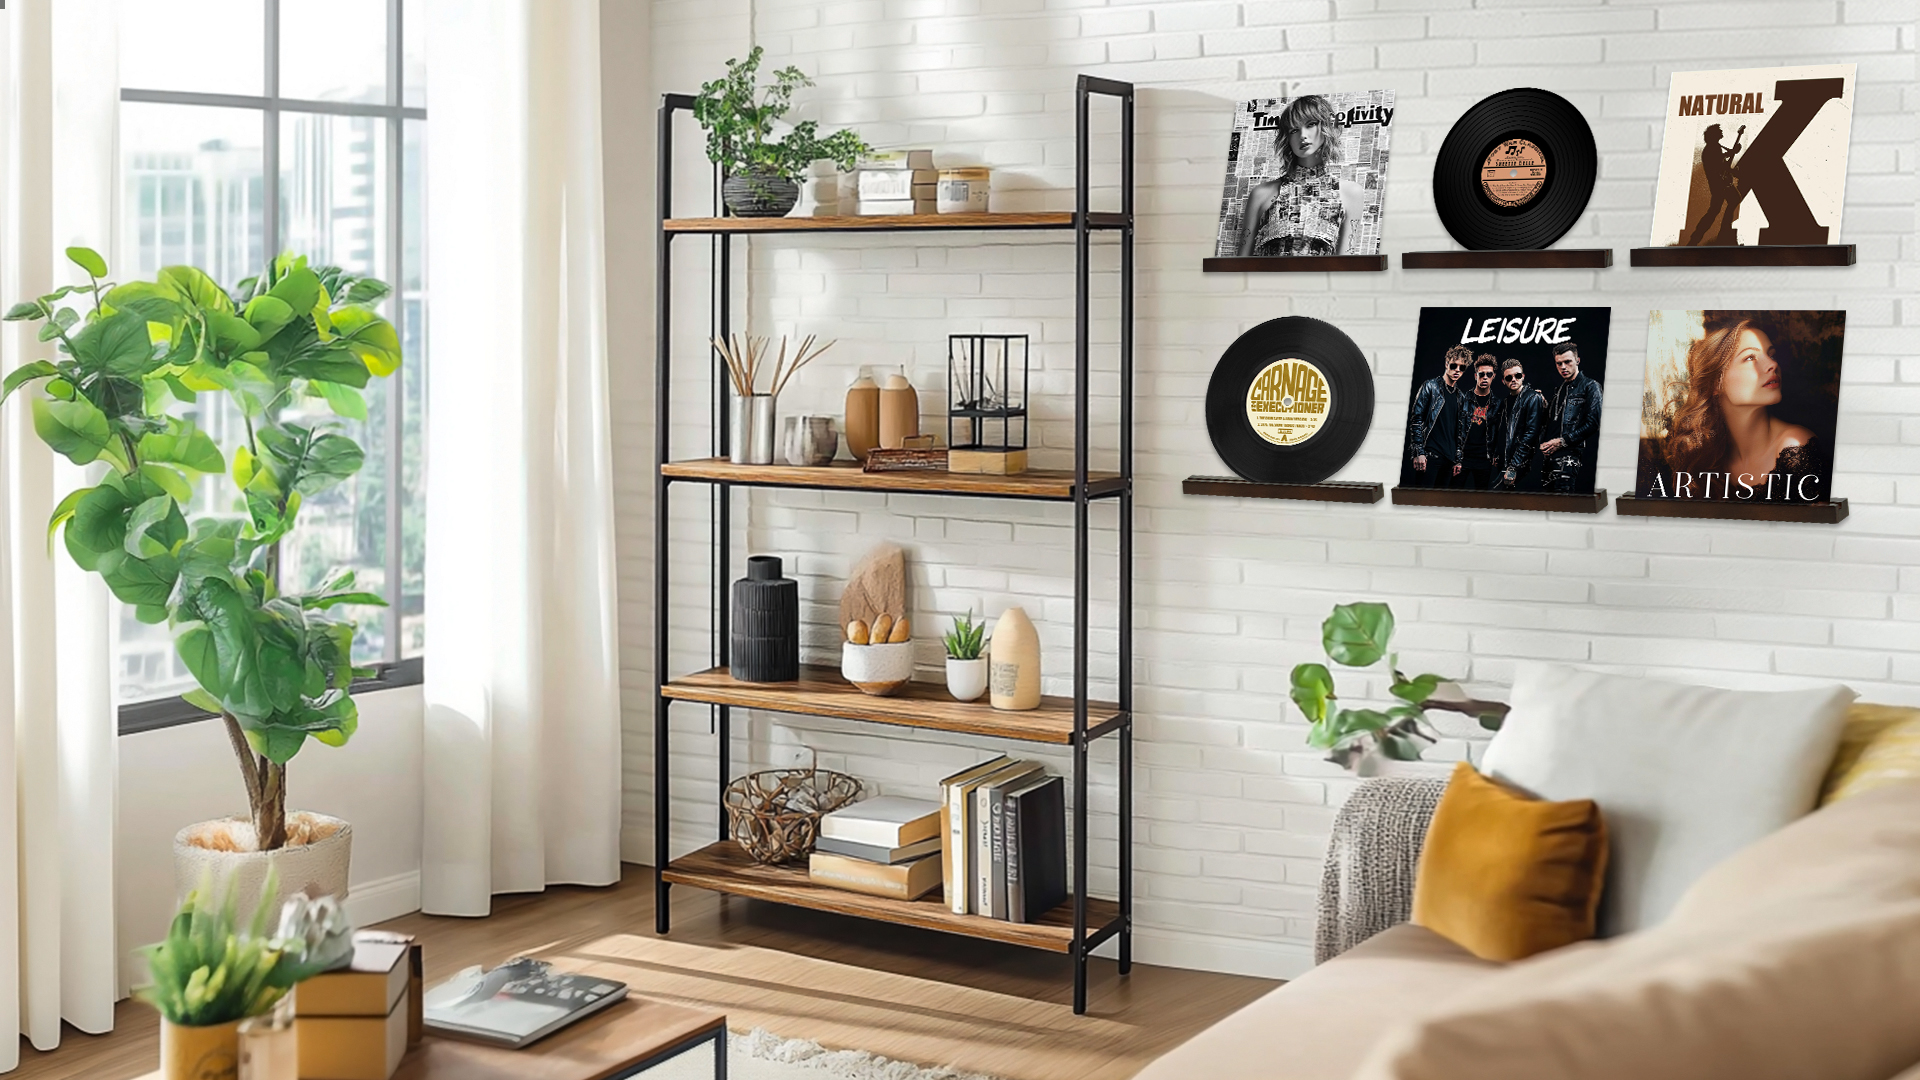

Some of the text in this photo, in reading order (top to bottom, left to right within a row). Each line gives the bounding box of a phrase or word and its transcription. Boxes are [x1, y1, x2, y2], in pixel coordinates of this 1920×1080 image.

[1678, 92, 1764, 117] NATURAL
[1253, 112, 1281, 127] Tim
[1679, 77, 1845, 247] K
[1460, 316, 1577, 345] LEISURE
[1250, 362, 1327, 402] CARNAGE
[1646, 471, 1820, 501] ARTISTIC
